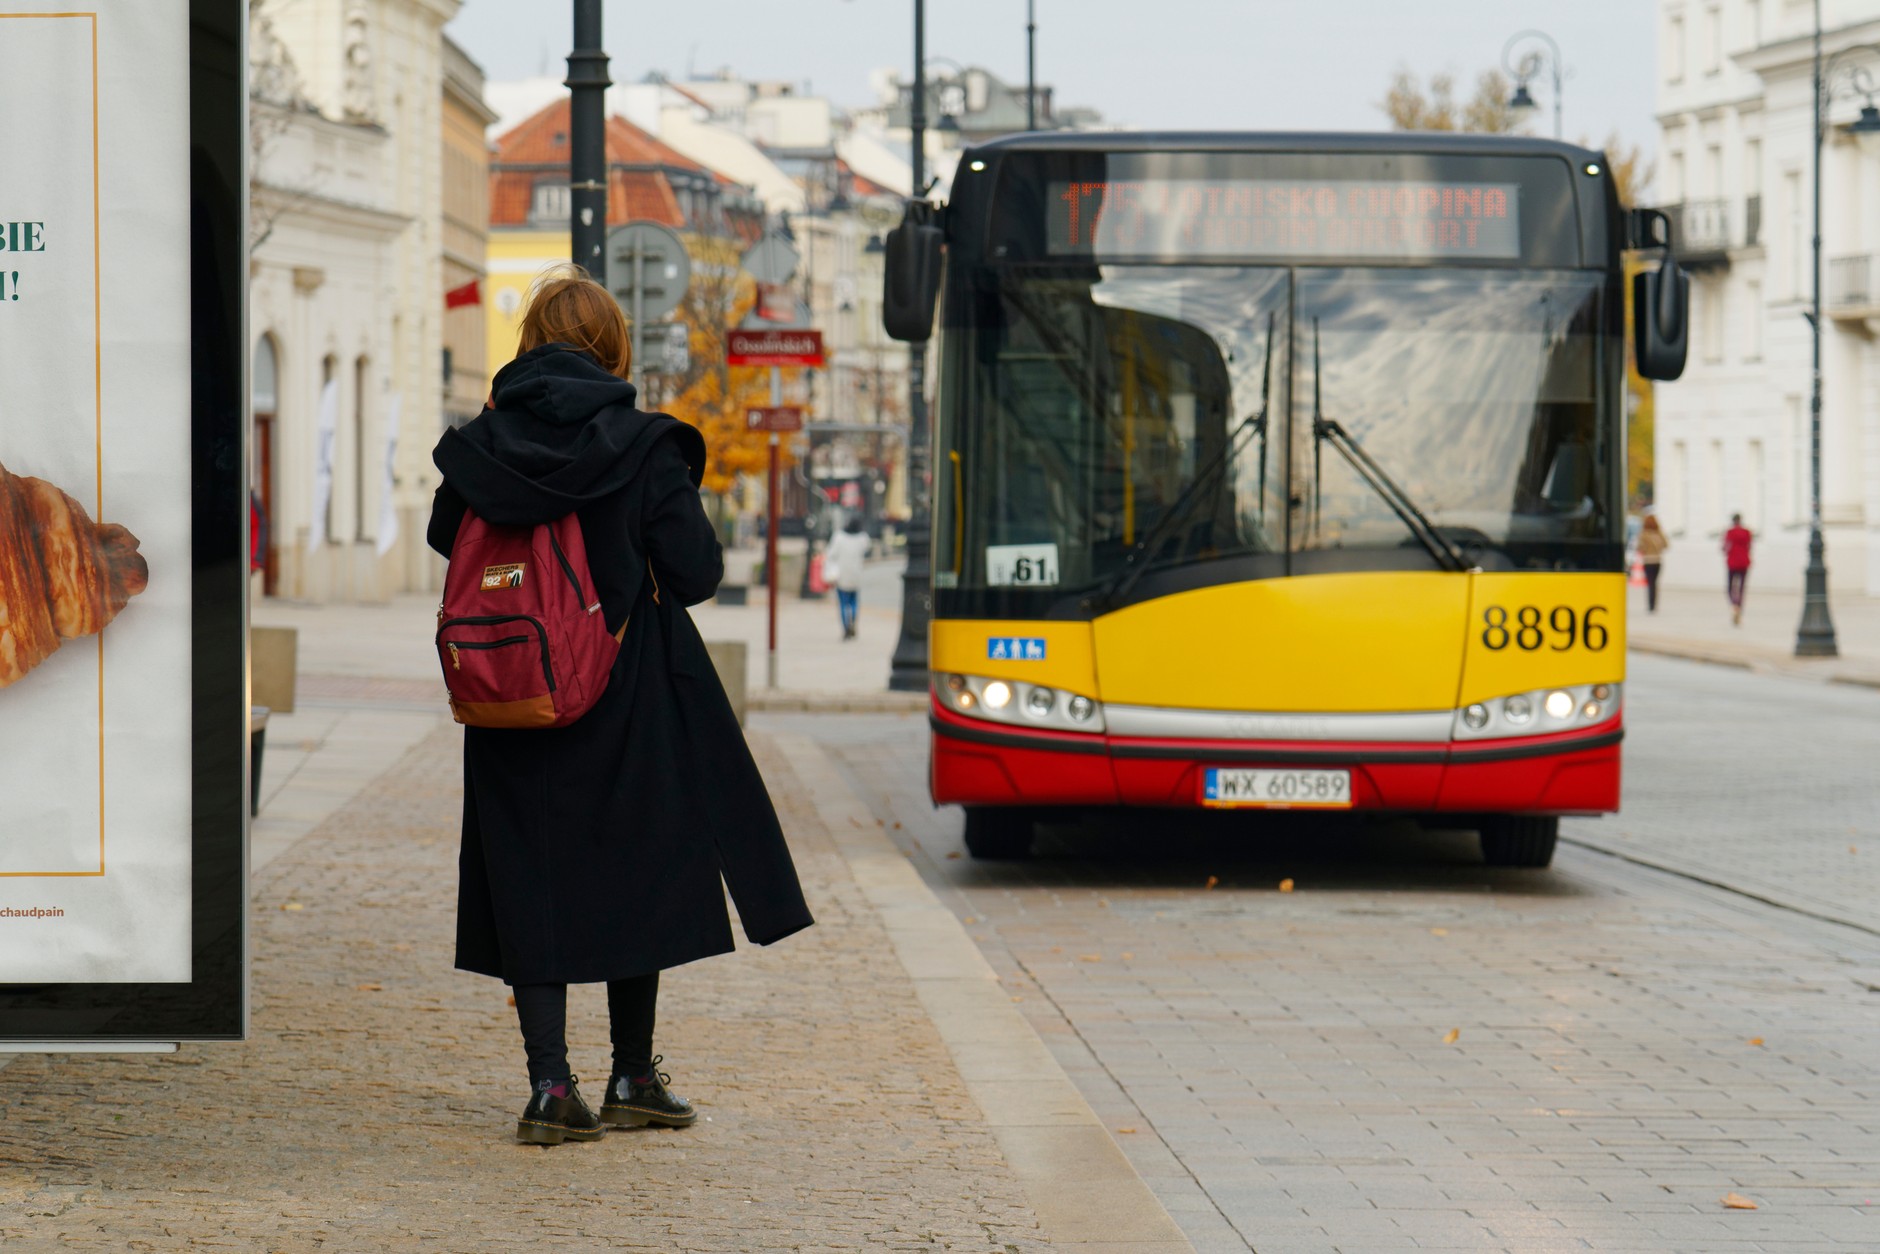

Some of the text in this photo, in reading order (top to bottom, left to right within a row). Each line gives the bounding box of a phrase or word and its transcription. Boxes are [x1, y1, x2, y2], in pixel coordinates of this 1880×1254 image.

[1061, 183, 1507, 246] 175 LOTNISKO CHOPINA
[487, 564, 519, 573] SKECHERS
[1015, 557, 1046, 582] 61
[1482, 605, 1609, 652] 8896
[1222, 773, 1346, 797] WX 60589
[0, 906, 65, 920] chaudpain
